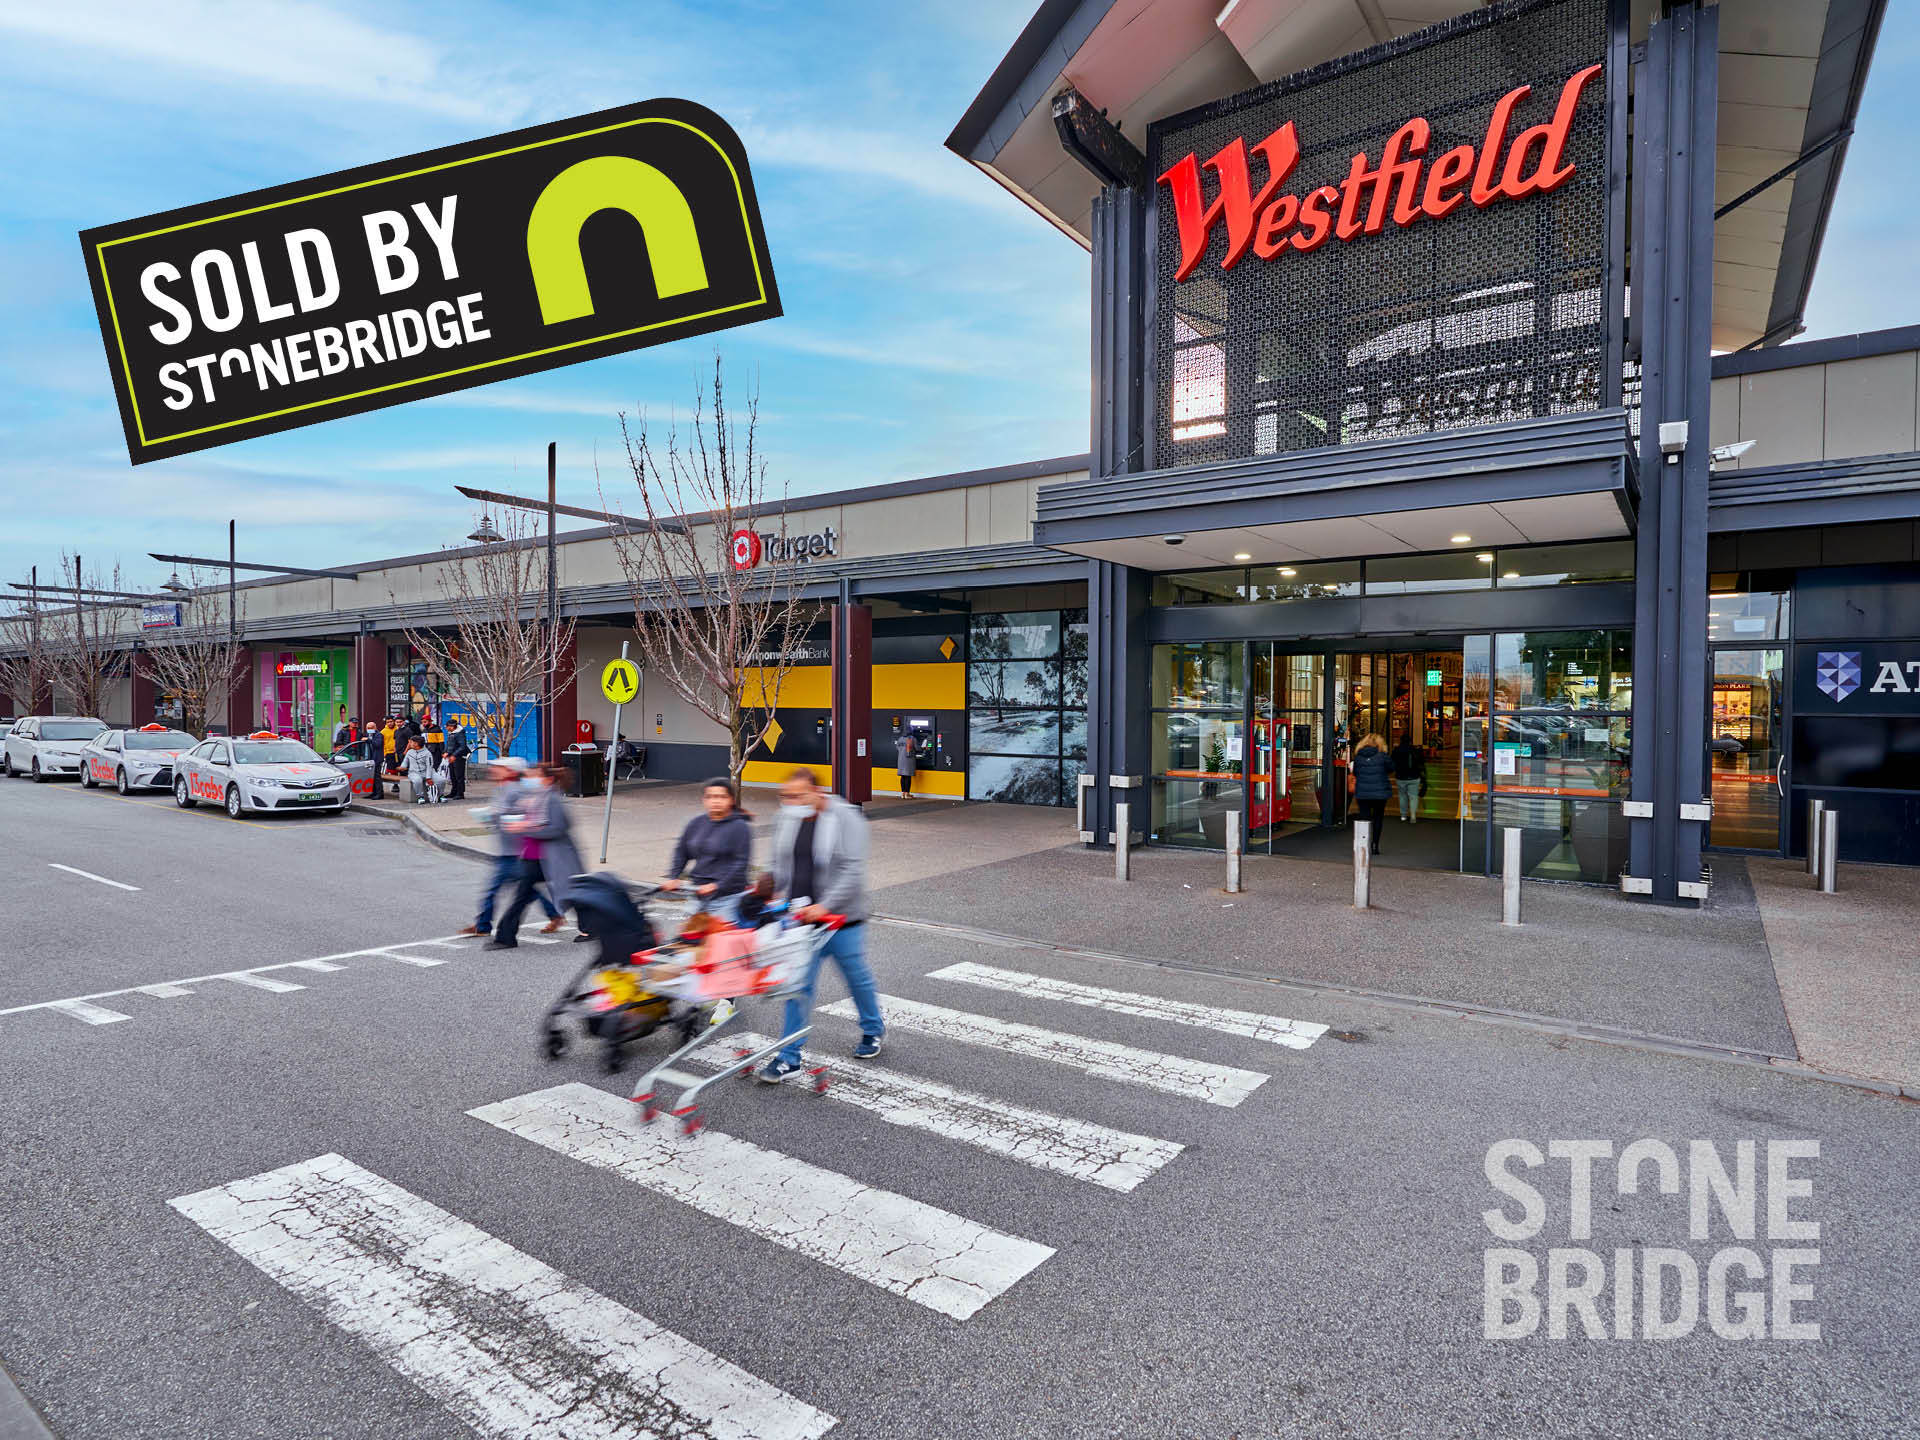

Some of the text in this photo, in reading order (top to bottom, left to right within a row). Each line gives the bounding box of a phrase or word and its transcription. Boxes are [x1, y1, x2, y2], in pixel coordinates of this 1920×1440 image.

[1157, 64, 1601, 283] Westfield
[760, 527, 837, 564] Target
[90, 758, 116, 780] 13cabs
[190, 772, 224, 800] 13cabs
